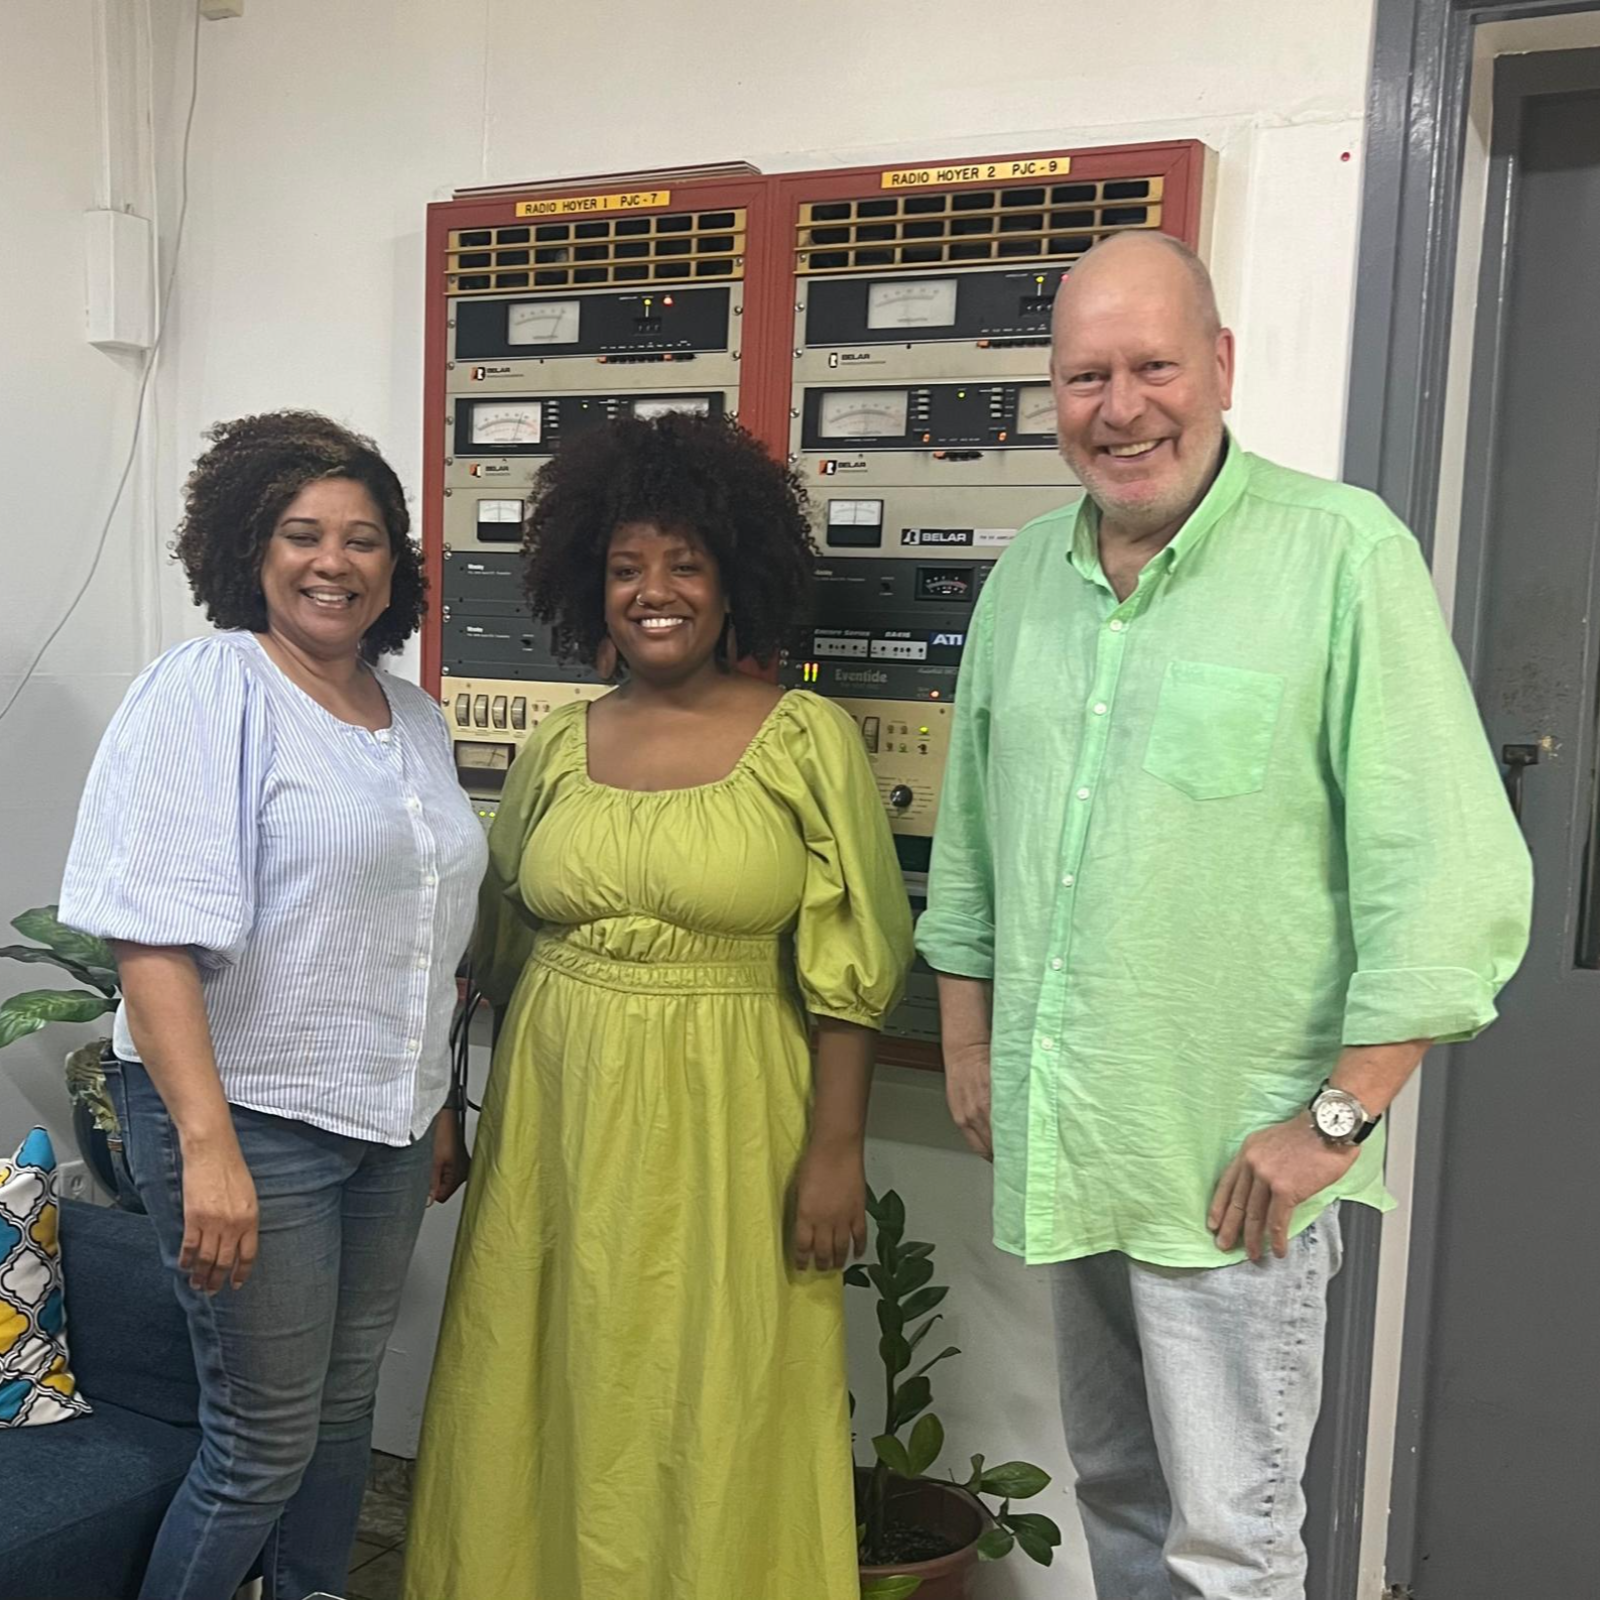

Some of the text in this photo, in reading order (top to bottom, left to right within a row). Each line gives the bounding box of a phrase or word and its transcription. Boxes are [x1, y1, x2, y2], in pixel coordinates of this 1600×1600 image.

[892, 171, 930, 185] RADIO
[937, 168, 979, 182] HOYER
[987, 166, 995, 178] 2
[525, 202, 557, 214] RADIO
[563, 198, 597, 211] HOYER
[922, 532, 966, 542] BELAR
[932, 634, 963, 645] ATI
[835, 668, 888, 683] Eventide
